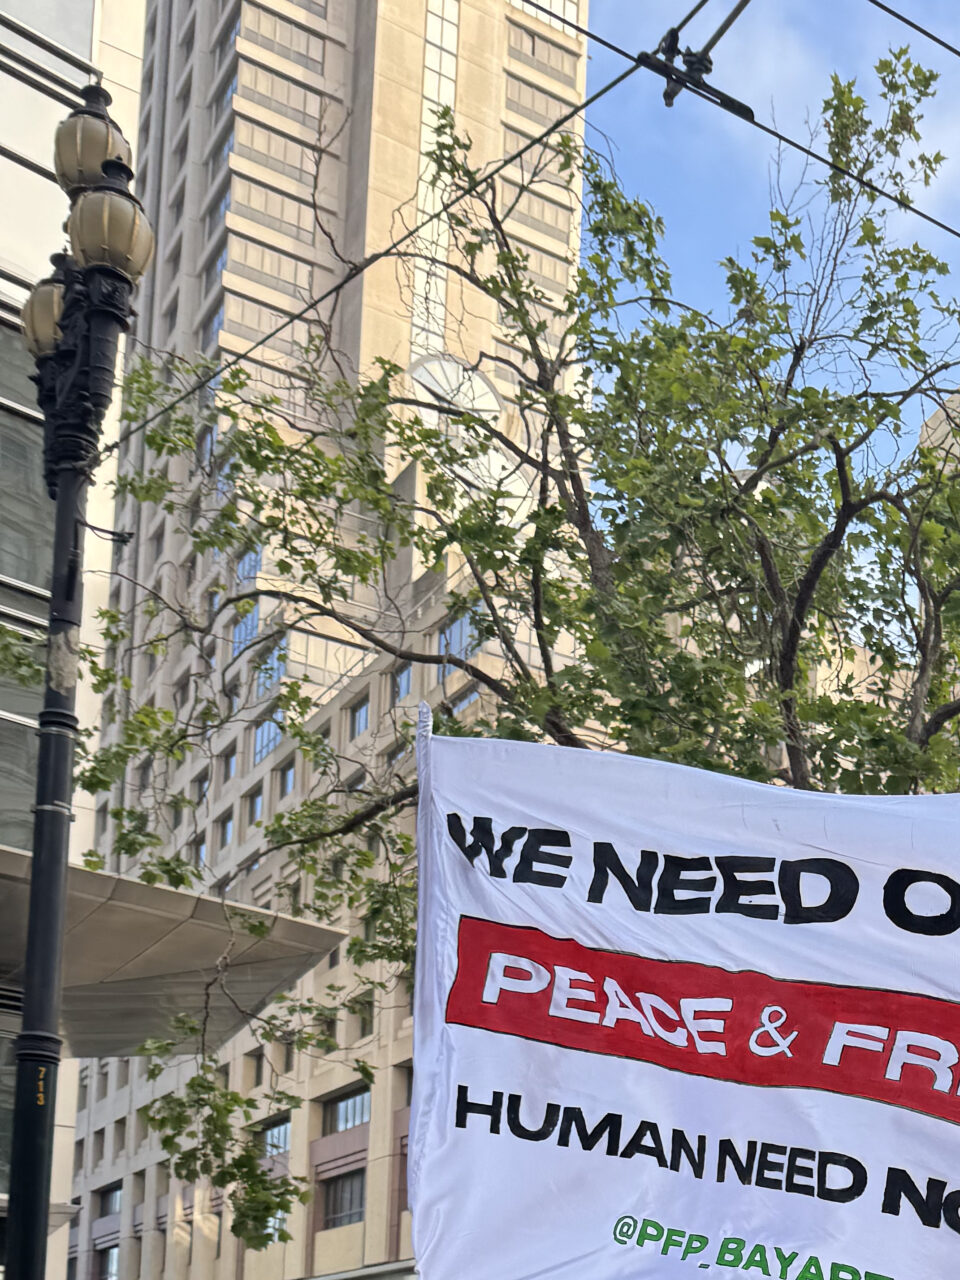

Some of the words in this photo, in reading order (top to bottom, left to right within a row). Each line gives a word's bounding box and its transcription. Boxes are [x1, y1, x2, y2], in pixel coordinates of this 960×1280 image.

[447, 812, 572, 887] WE
[587, 842, 859, 925] NEED
[481, 952, 733, 1056] PEACE
[748, 1004, 795, 1058] &
[455, 1084, 705, 1179] HUMAN
[716, 1139, 868, 1203] NEED
